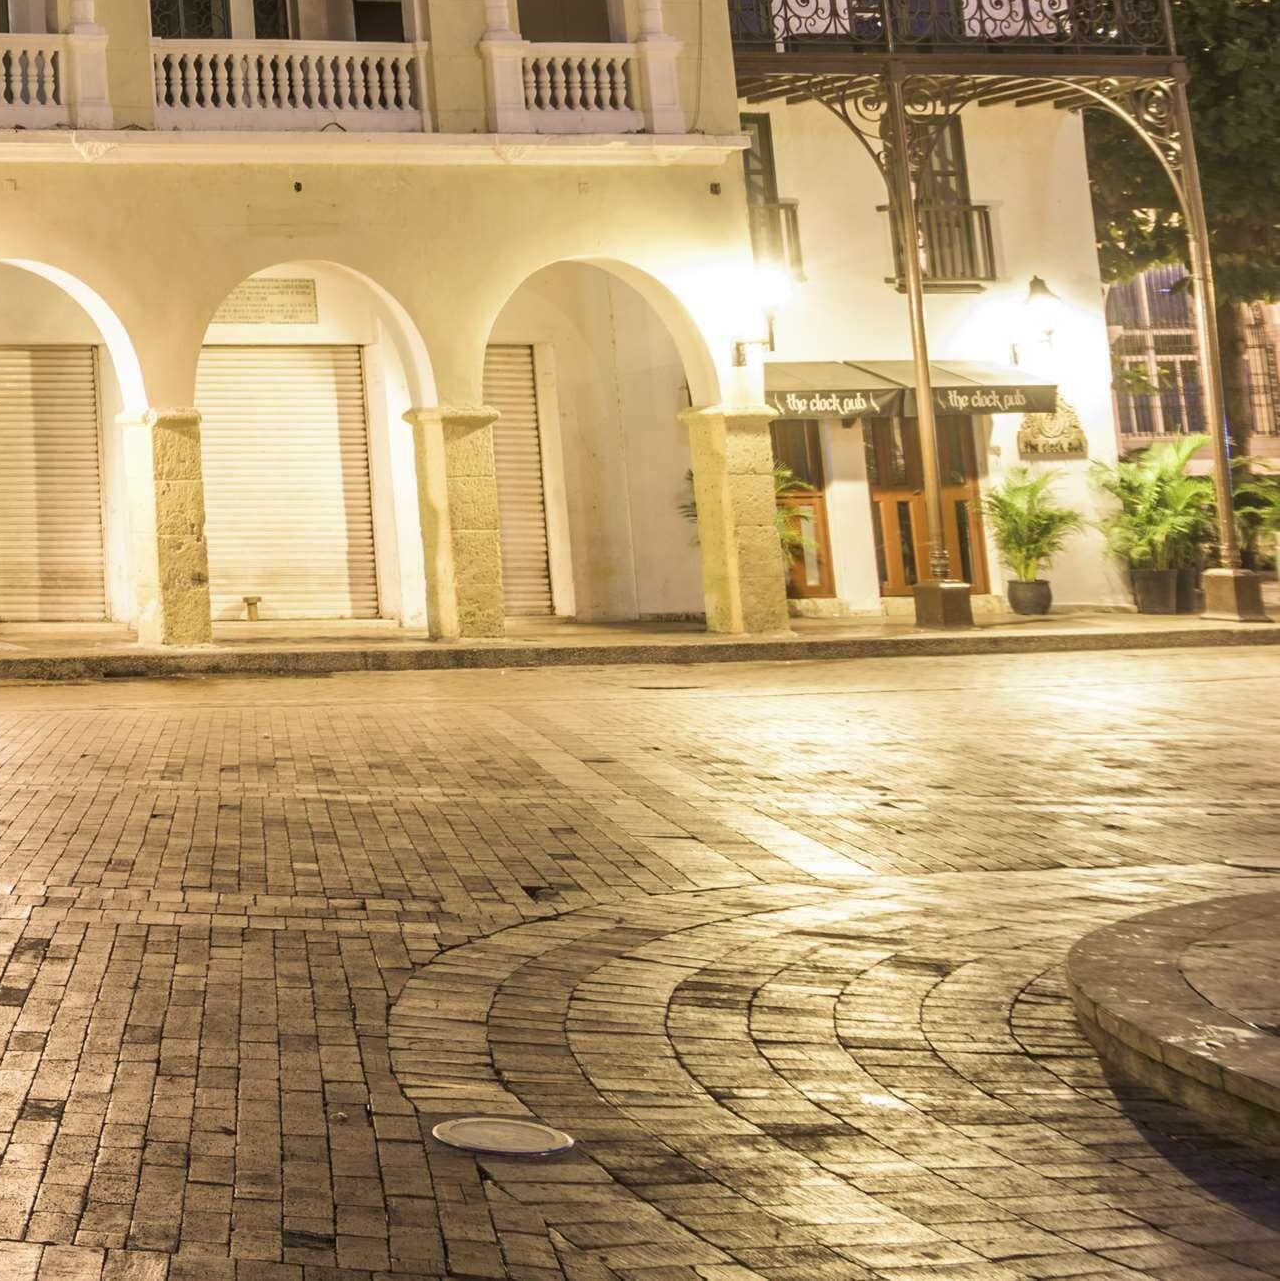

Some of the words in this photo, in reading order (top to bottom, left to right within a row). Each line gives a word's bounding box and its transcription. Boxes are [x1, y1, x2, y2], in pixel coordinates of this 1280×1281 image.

[786, 393, 807, 414] the
[809, 393, 844, 415] clock
[843, 392, 867, 413] pub
[948, 390, 968, 411] the
[971, 390, 1004, 411] clock
[1003, 390, 1026, 410] pub
